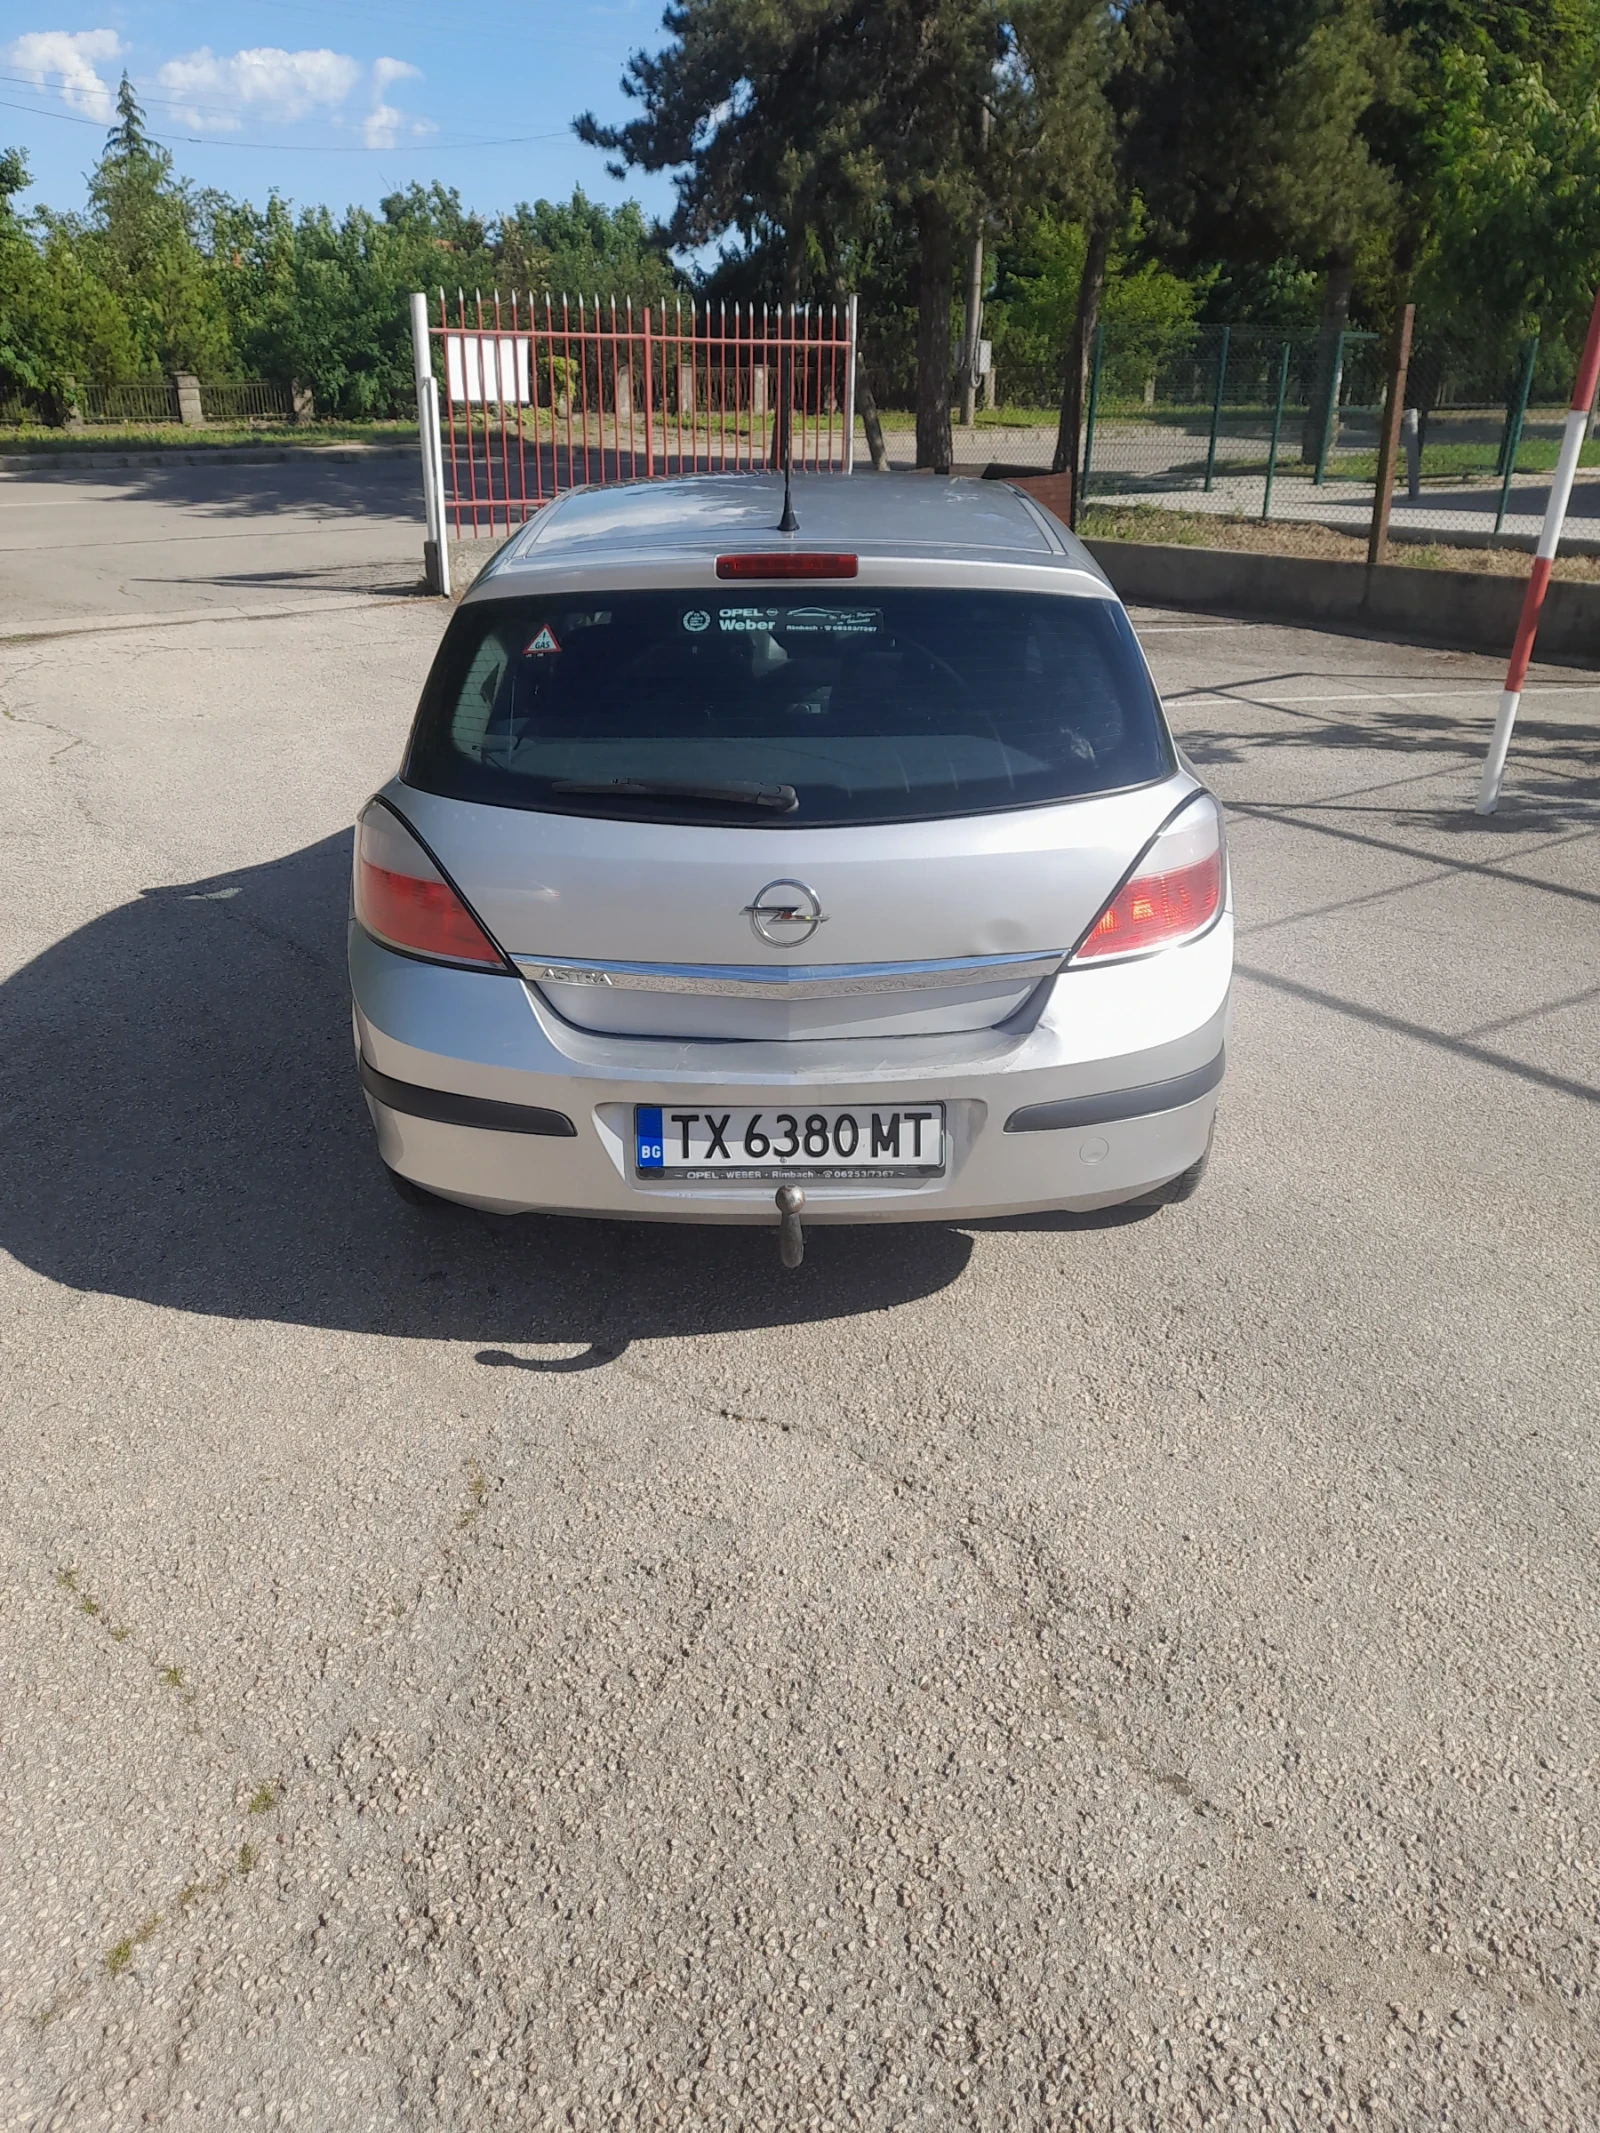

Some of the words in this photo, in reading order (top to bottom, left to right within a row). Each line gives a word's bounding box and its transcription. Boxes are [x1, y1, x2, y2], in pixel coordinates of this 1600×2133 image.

[719, 608, 764, 617] OPEL
[719, 619, 776, 631] Weber
[535, 641, 550, 649] GAS
[541, 968, 613, 986] ASTRA
[671, 1114, 731, 1159] TX
[744, 1113, 859, 1158] 6380
[870, 1112, 932, 1158] MT
[641, 1145, 661, 1159] BG
[687, 1171, 719, 1179] OPEL
[726, 1171, 761, 1179] WEBER
[771, 1170, 814, 1179] Rimbach
